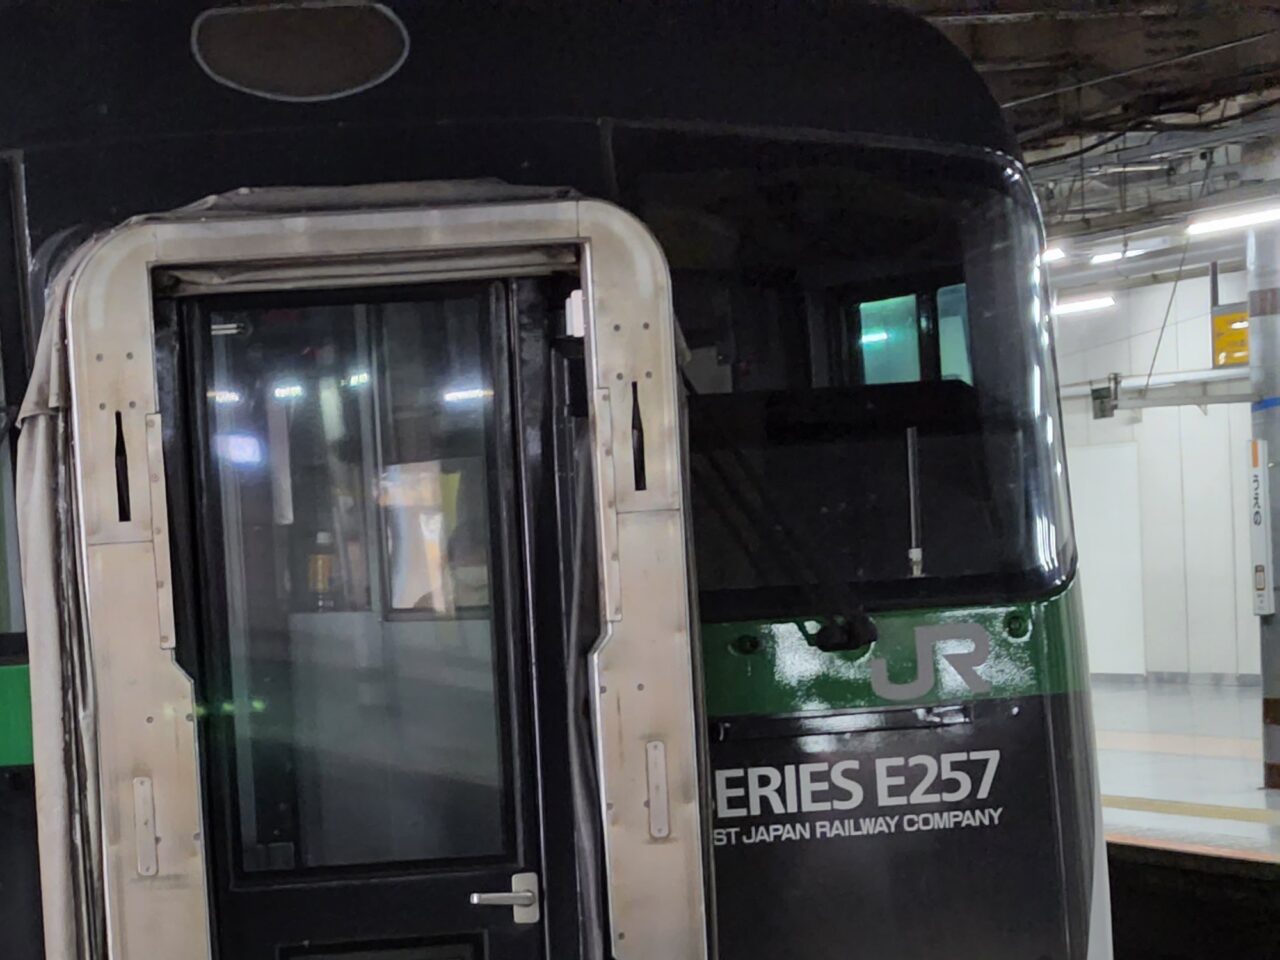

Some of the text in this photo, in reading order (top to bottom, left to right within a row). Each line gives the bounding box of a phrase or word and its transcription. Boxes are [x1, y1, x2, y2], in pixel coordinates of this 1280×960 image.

[871, 622, 992, 701] JR
[713, 749, 1001, 818] ERIES E257
[742, 821, 811, 844] JAPAN
[815, 815, 900, 839] RAILWAY
[903, 807, 1003, 830] COMPANY
